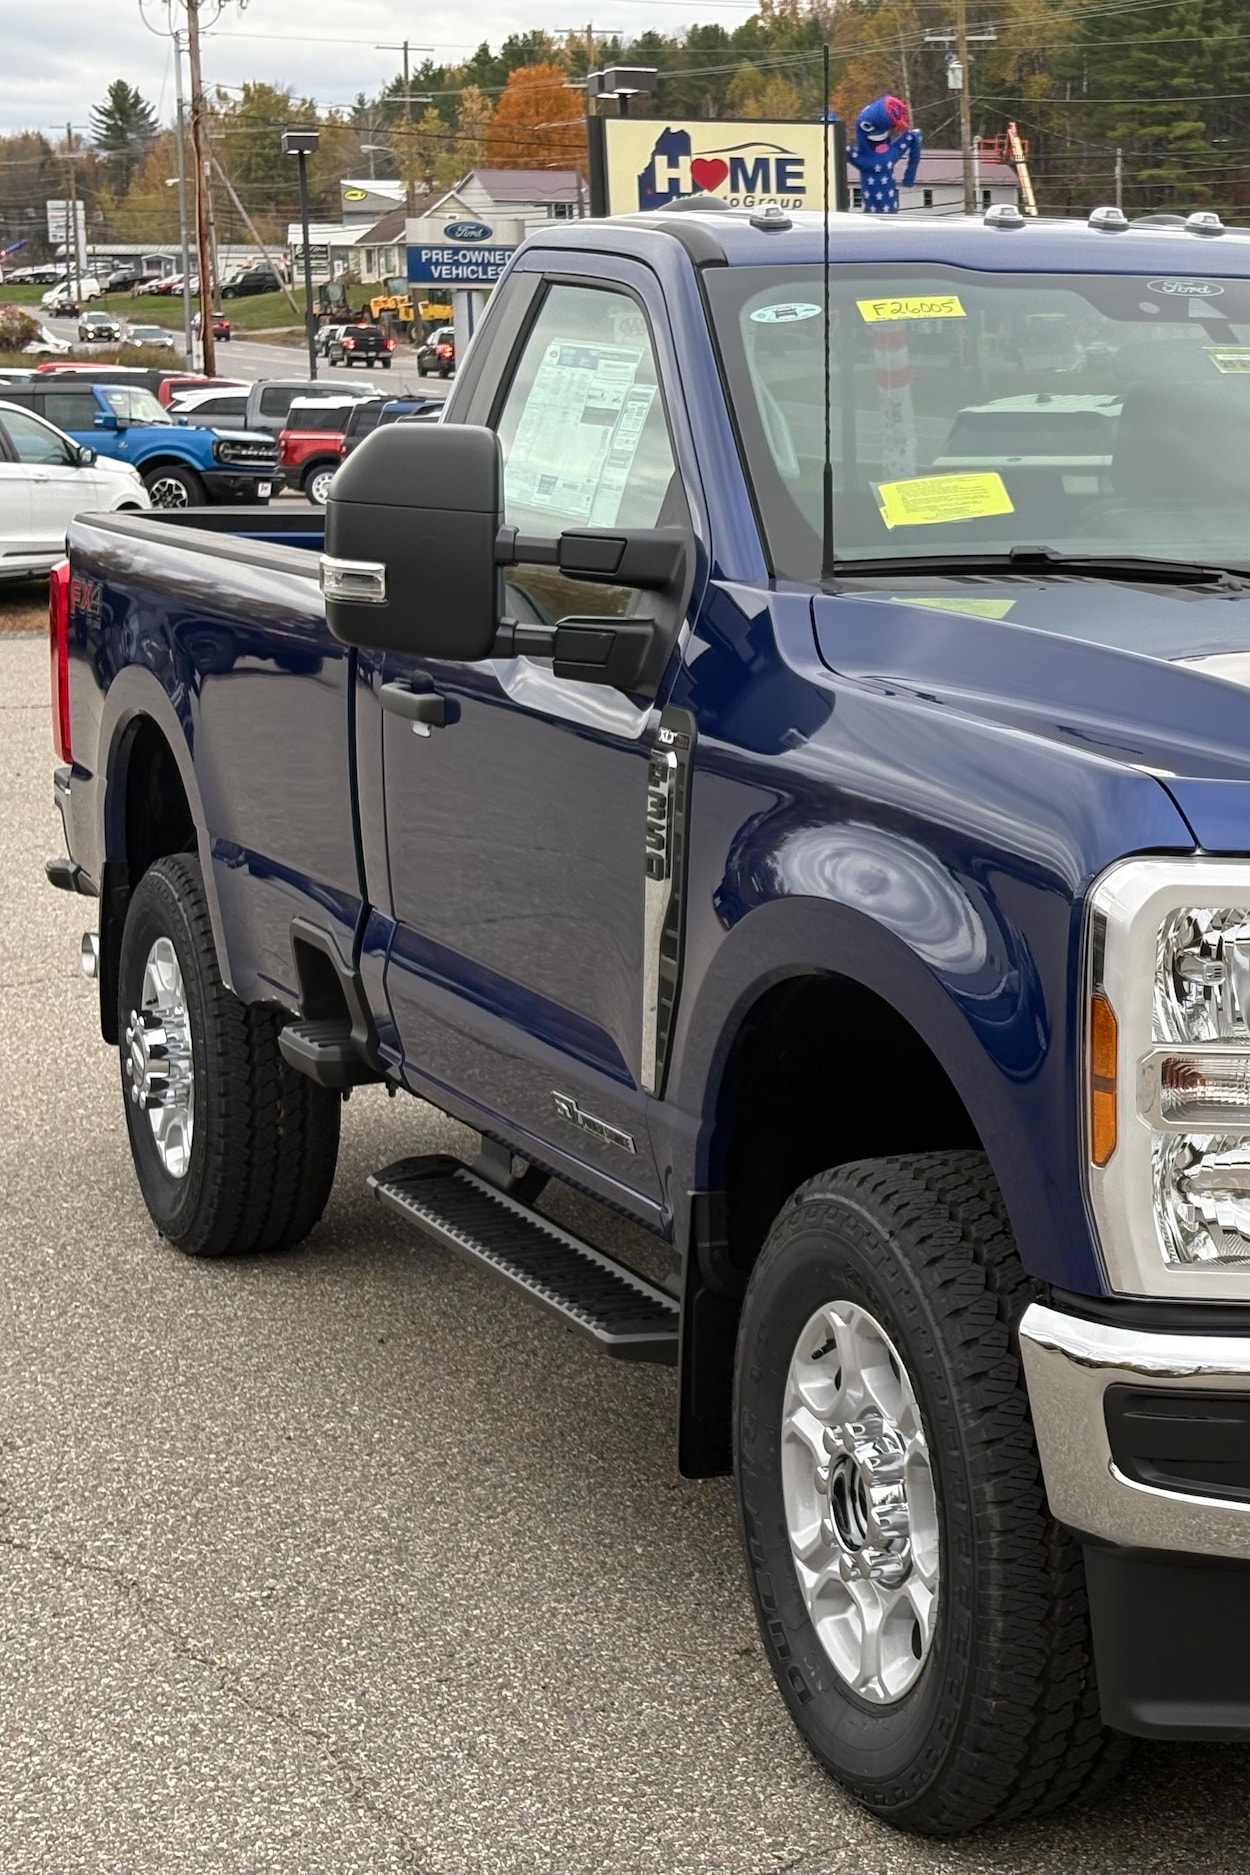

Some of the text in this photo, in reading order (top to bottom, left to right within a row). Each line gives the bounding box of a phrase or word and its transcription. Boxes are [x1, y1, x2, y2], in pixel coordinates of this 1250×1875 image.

[455, 225, 483, 238] Ford
[1162, 281, 1211, 294] Ford
[872, 298, 957, 316] F26005
[70, 577, 103, 617] FX4
[658, 726, 677, 744] XLT
